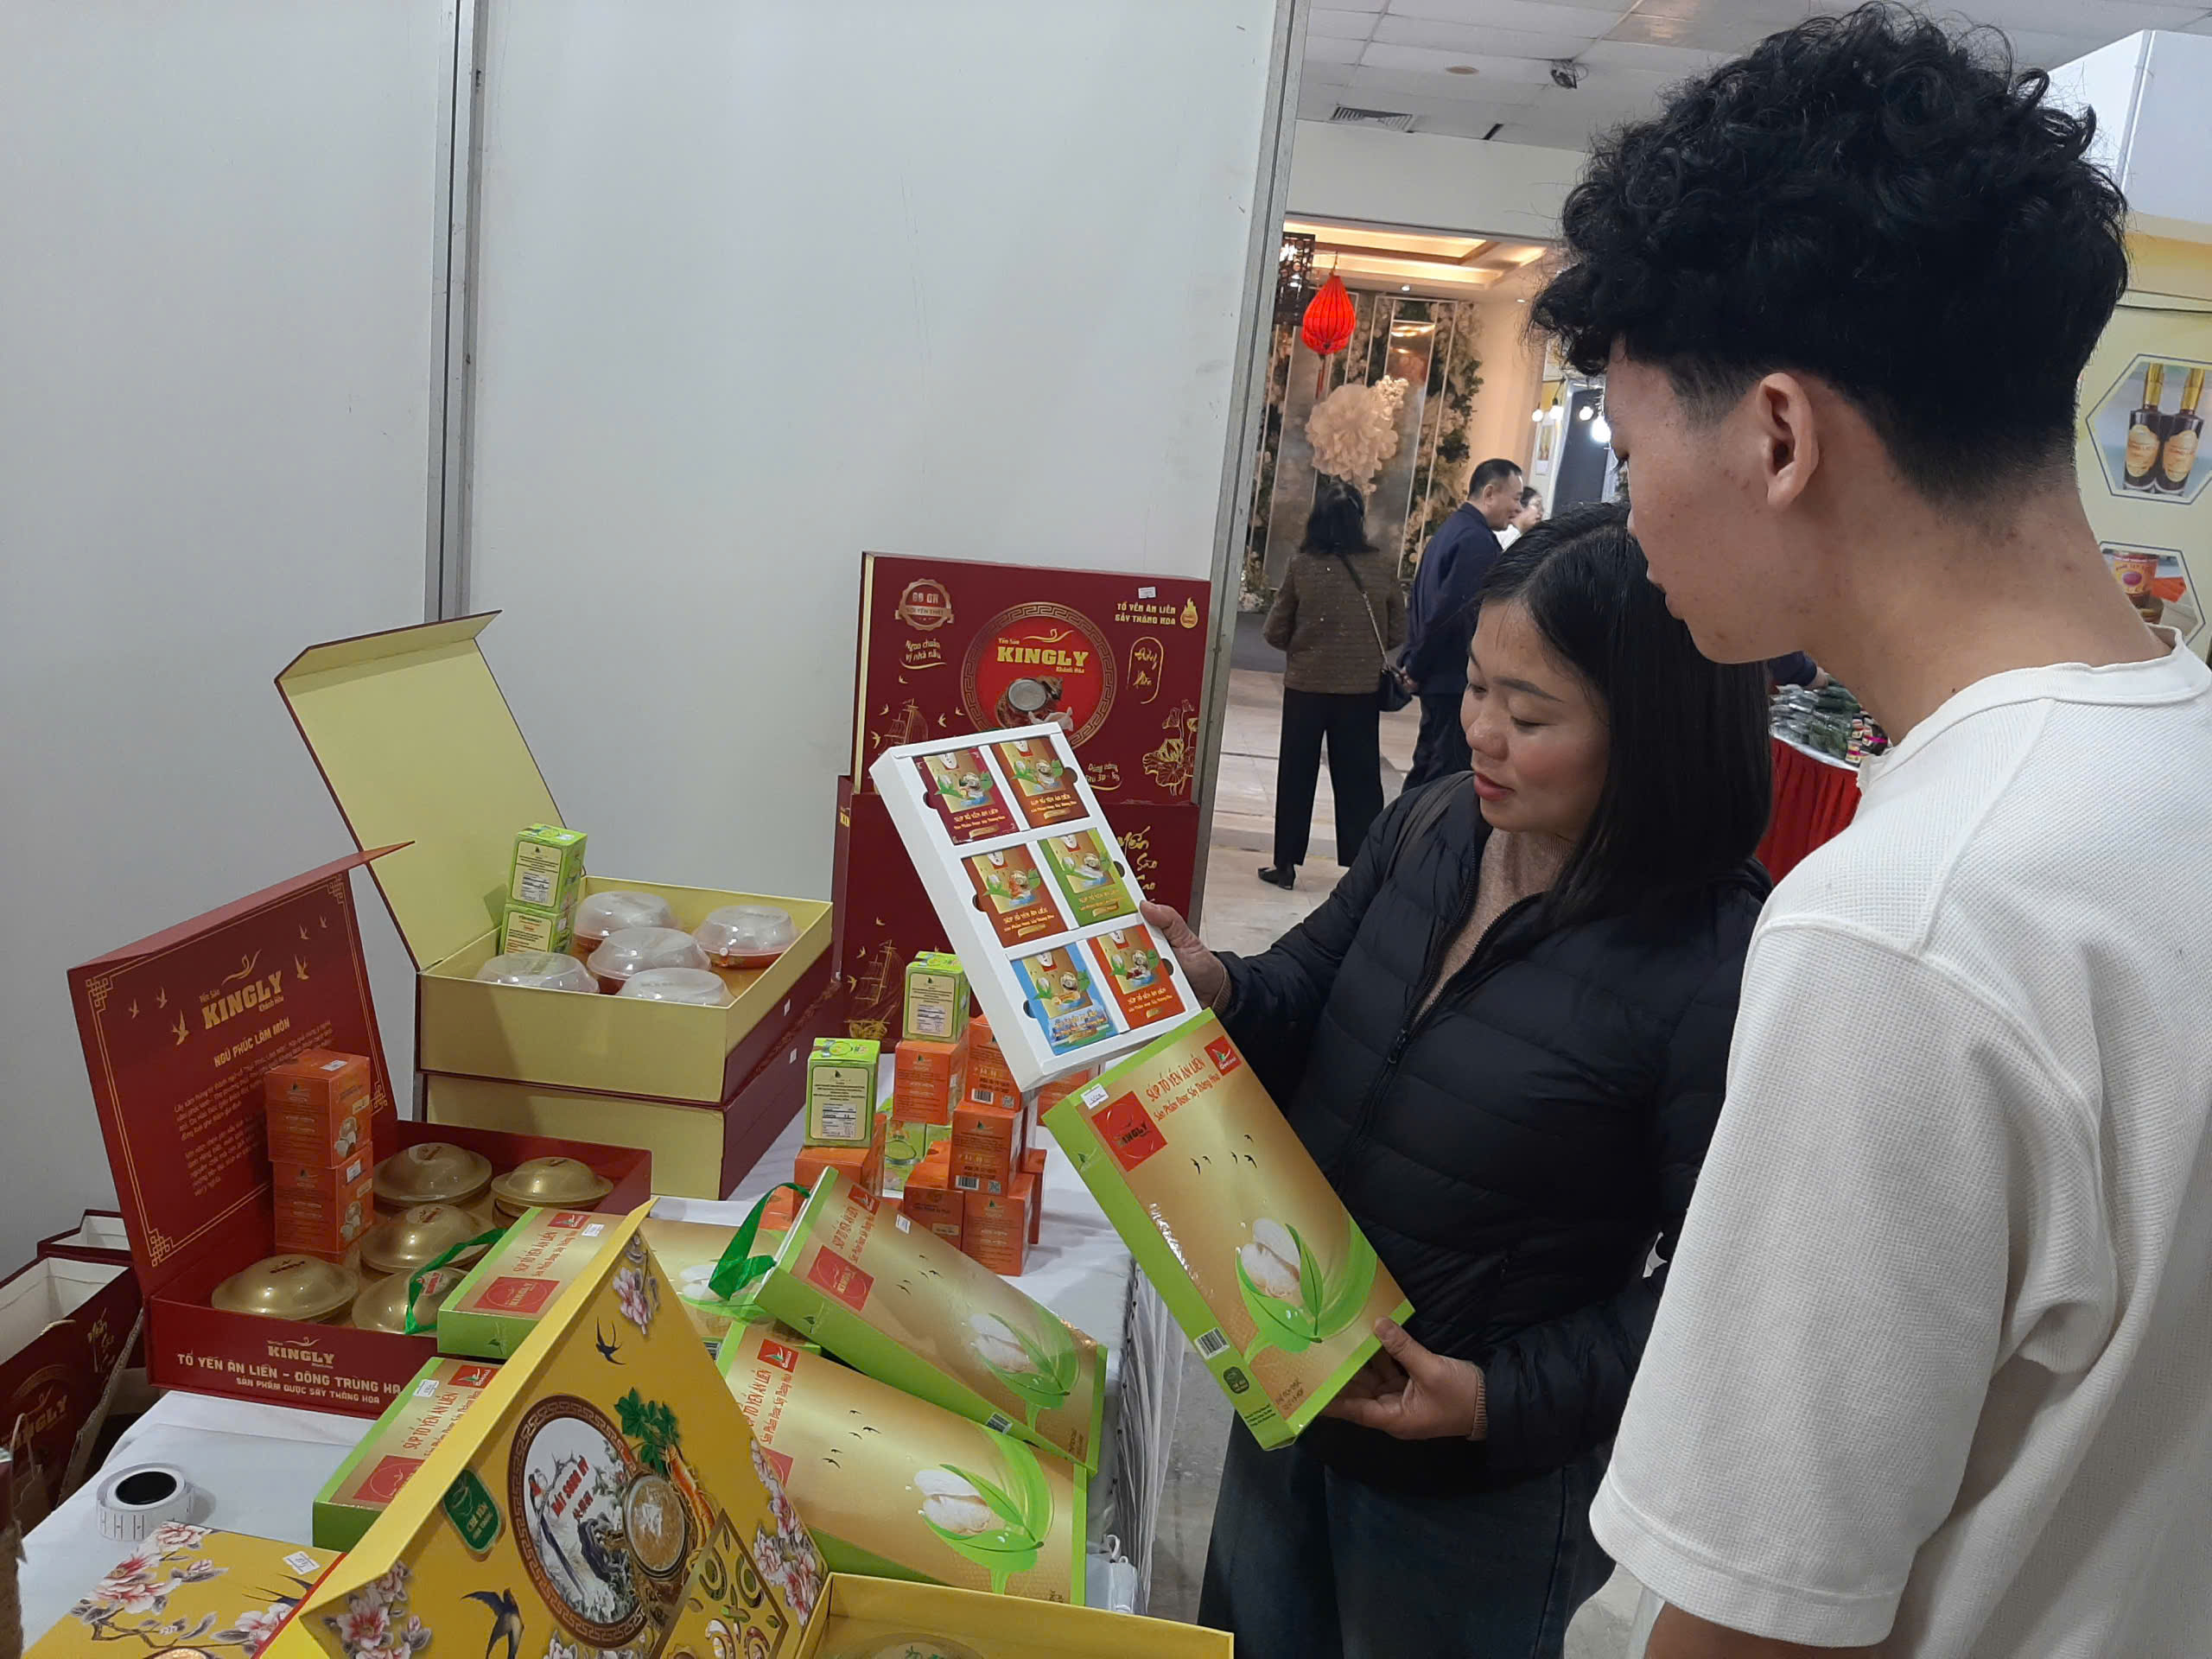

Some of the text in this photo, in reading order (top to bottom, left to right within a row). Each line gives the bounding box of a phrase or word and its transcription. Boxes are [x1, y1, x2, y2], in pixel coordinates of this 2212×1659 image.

[997, 646, 1089, 667] KINGLY
[201, 970, 283, 1030] KINGLY
[232, 1037, 254, 1058] PHÚC
[255, 1027, 272, 1045] LÂM
[1146, 1083, 1161, 1102] SÚP
[1159, 1071, 1171, 1093] TỔ
[1169, 1067, 1184, 1087] YẾN
[1179, 1065, 1193, 1079] ĂN
[267, 1344, 335, 1364] KINGLY
[177, 1349, 194, 1366] TỔ
[198, 1355, 224, 1371] YẾN
[227, 1359, 245, 1374] ĂN
[249, 1363, 278, 1379] LIỀN
[295, 1370, 331, 1386] ĐÔNG
[334, 1376, 379, 1393] TRÙNG
[236, 1376, 254, 1387] SẢN
[283, 1384, 307, 1395] ĐƯỢC
[309, 1386, 327, 1397] SẤY
[329, 1389, 359, 1402] THĂNG
[361, 1395, 380, 1404] HOA
[742, 1392, 764, 1408] YẾN
